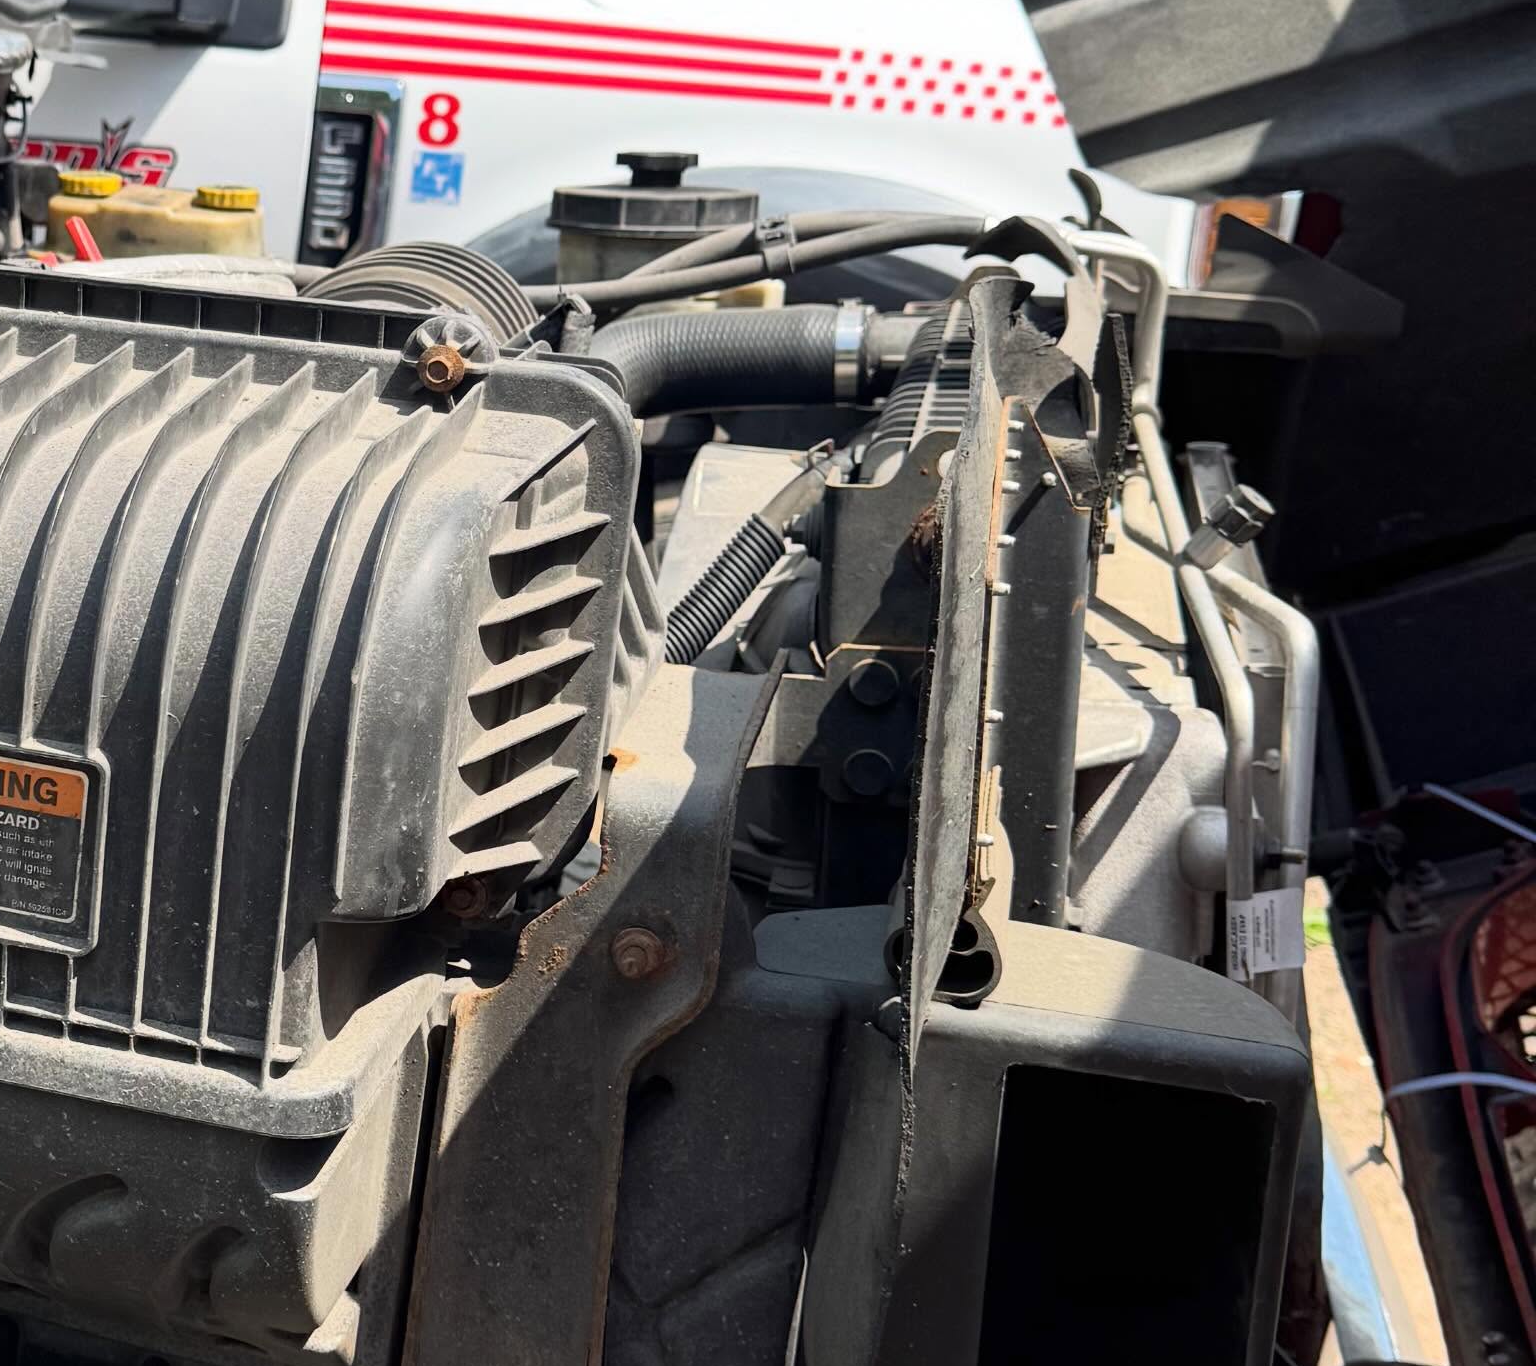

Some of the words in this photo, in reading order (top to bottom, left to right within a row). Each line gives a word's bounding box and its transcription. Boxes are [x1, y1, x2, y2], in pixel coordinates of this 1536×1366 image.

[418, 93, 460, 148] 8
[23, 835, 36, 844] as
[21, 849, 53, 862] intake
[5, 860, 22, 870] will
[24, 863, 52, 876] ignite
[4, 873, 46, 890] damage
